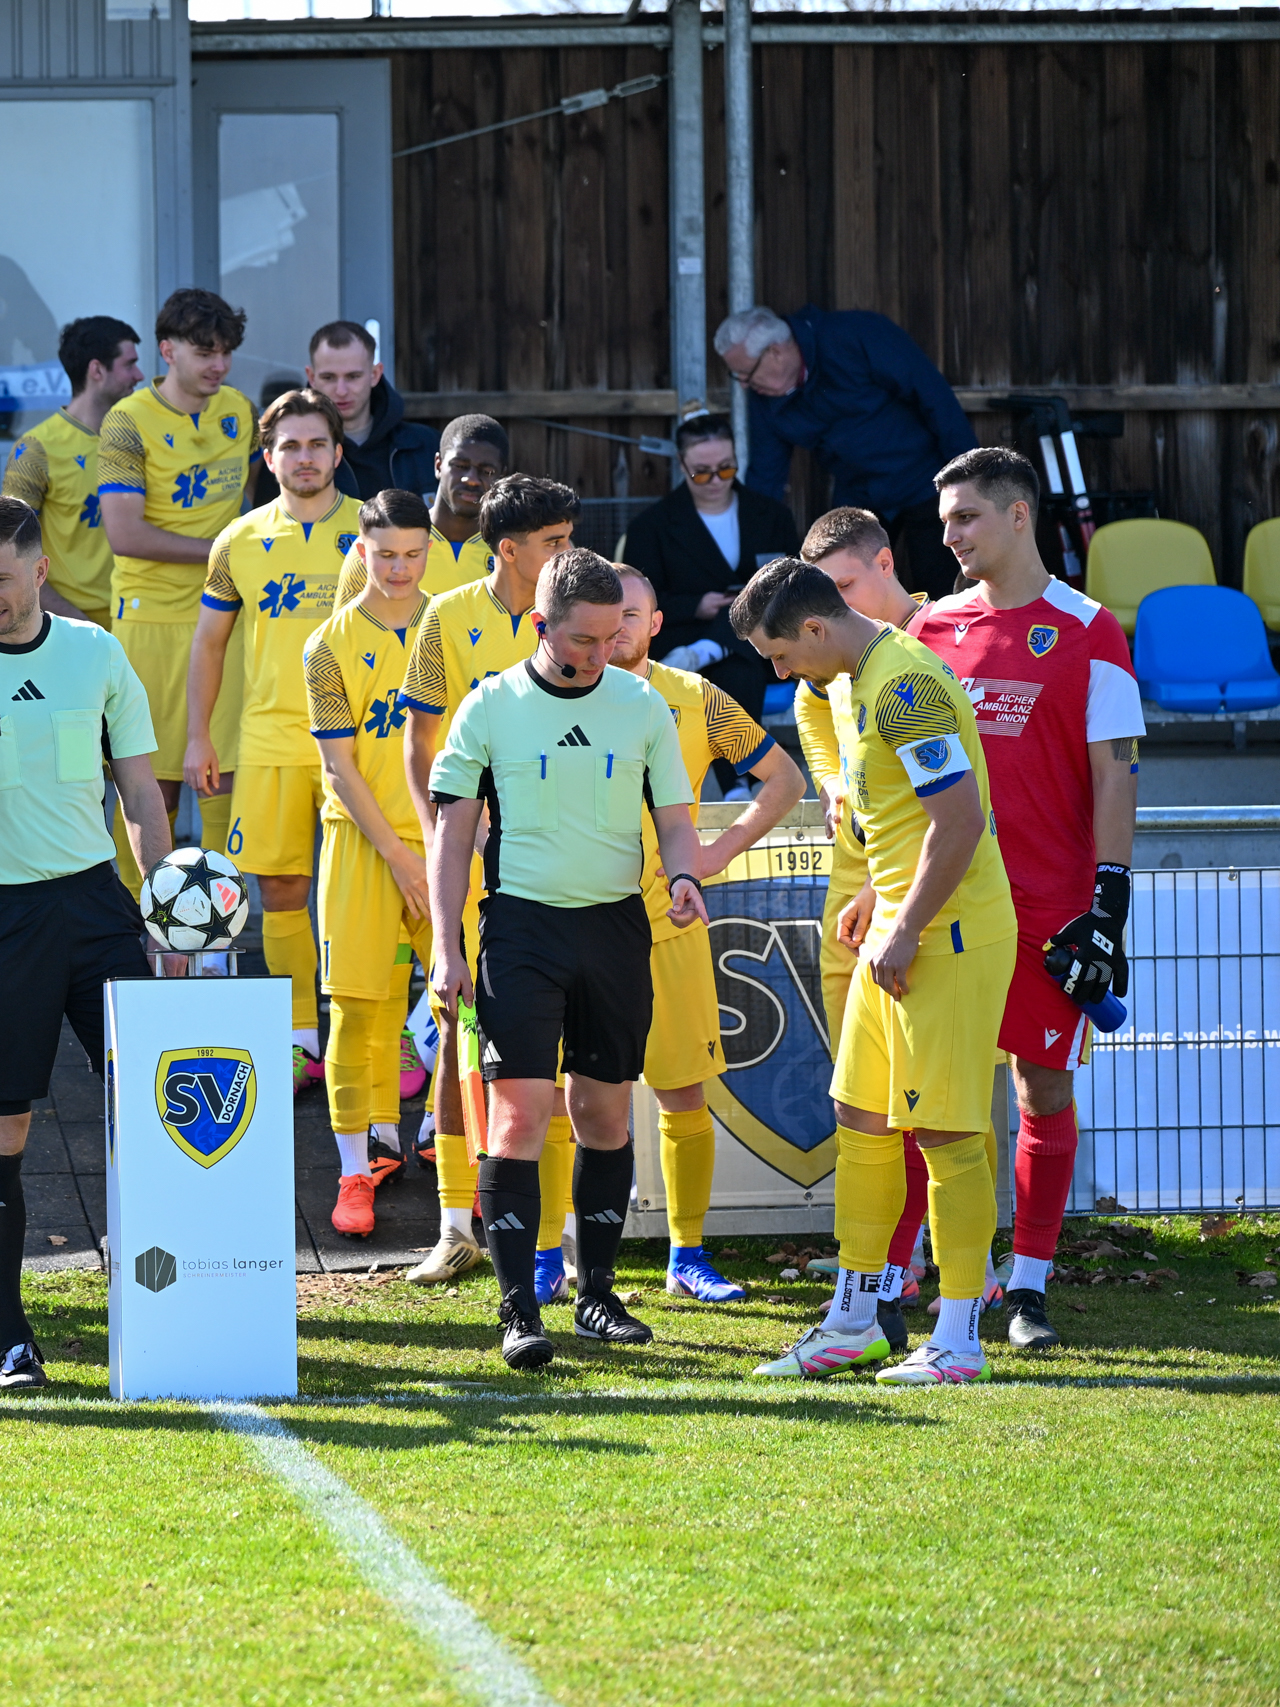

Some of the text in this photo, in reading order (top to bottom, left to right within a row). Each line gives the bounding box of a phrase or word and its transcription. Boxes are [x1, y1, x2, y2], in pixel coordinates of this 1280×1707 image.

[22, 370, 67, 395] e.V.
[976, 702, 1033, 714] AMBULANZ
[997, 694, 1036, 705] AICHER
[996, 713, 1029, 723] UNION
[227, 816, 243, 855] 6
[775, 850, 824, 872] 1992
[196, 1049, 214, 1057] 1992
[161, 1071, 233, 1127] SV
[221, 1064, 250, 1122] DORNACH
[182, 1257, 284, 1272] tobias langer
